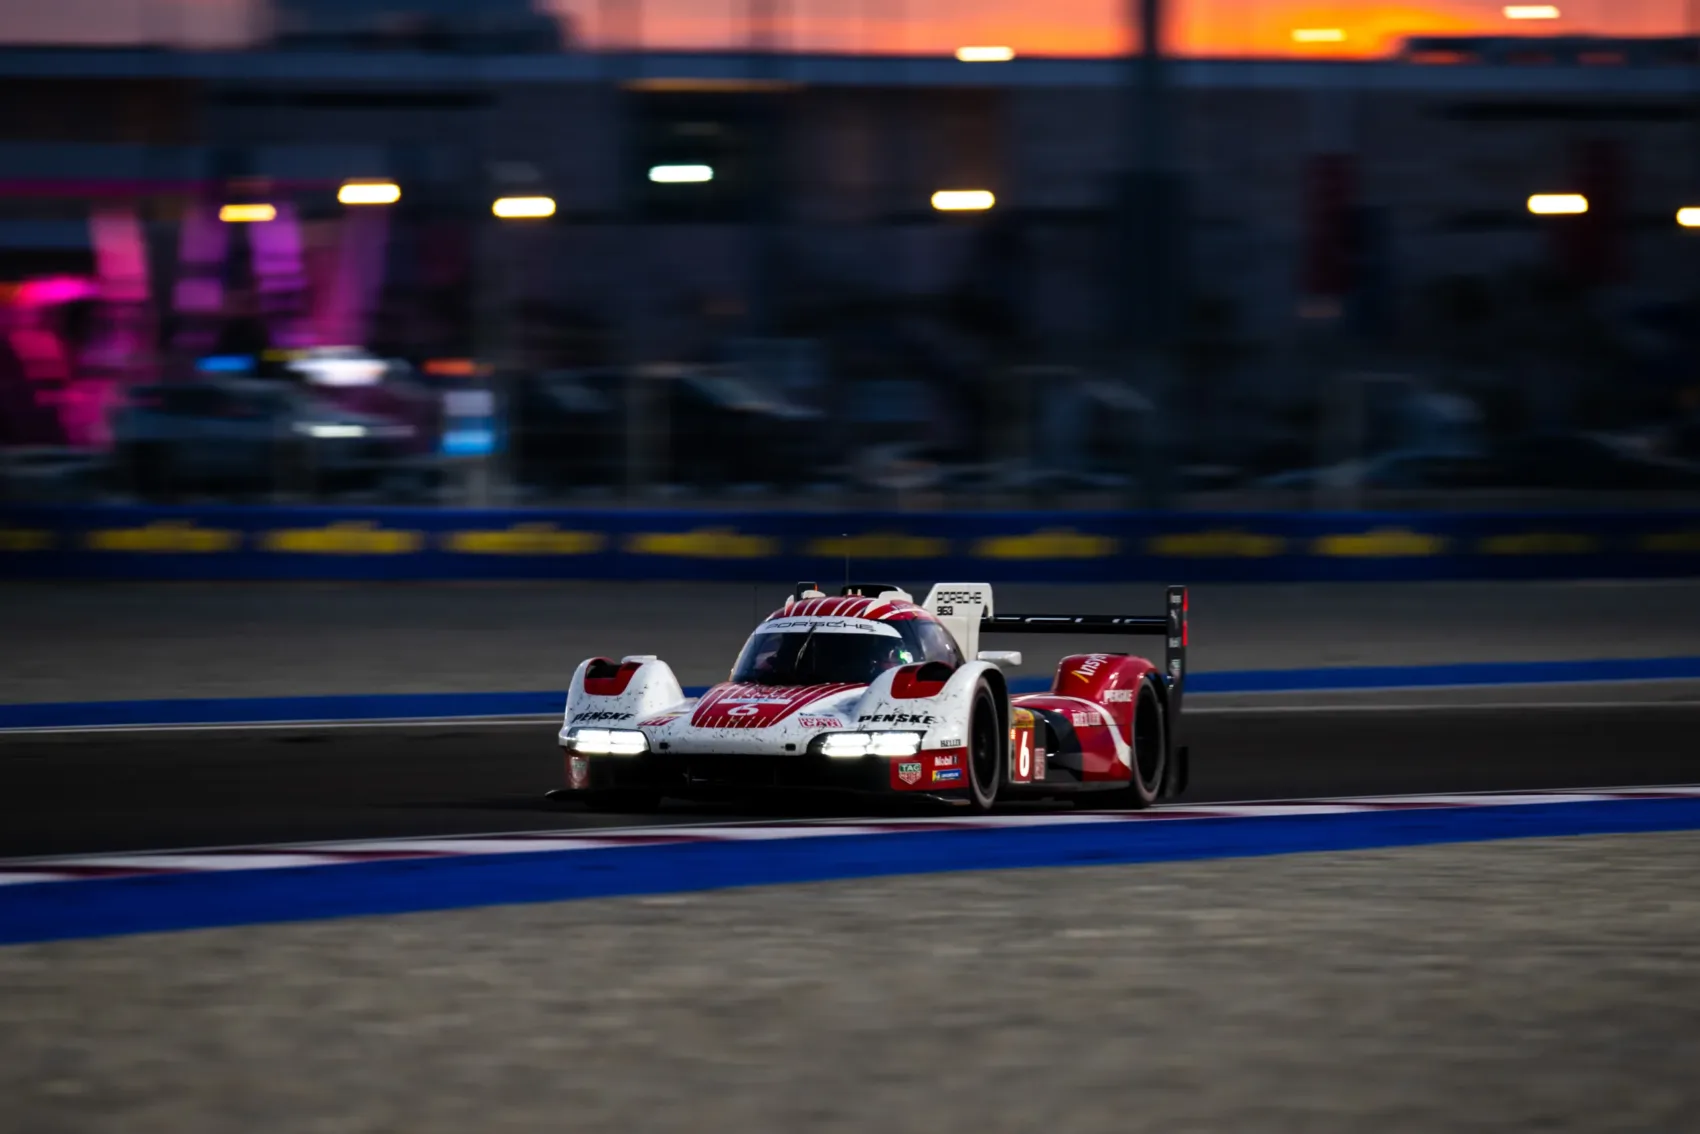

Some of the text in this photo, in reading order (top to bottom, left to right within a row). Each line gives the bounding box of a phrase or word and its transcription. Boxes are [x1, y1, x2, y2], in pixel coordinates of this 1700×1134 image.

[936, 591, 982, 605] PORSCHE
[936, 605, 953, 616] 963
[765, 620, 877, 632] PORSCHE
[727, 703, 760, 716] 6
[570, 711, 635, 724] PENSKE
[857, 713, 936, 725] PENSKE
[1019, 731, 1030, 777] 6
[934, 755, 953, 767] Mobil
[901, 763, 921, 772] TAG
